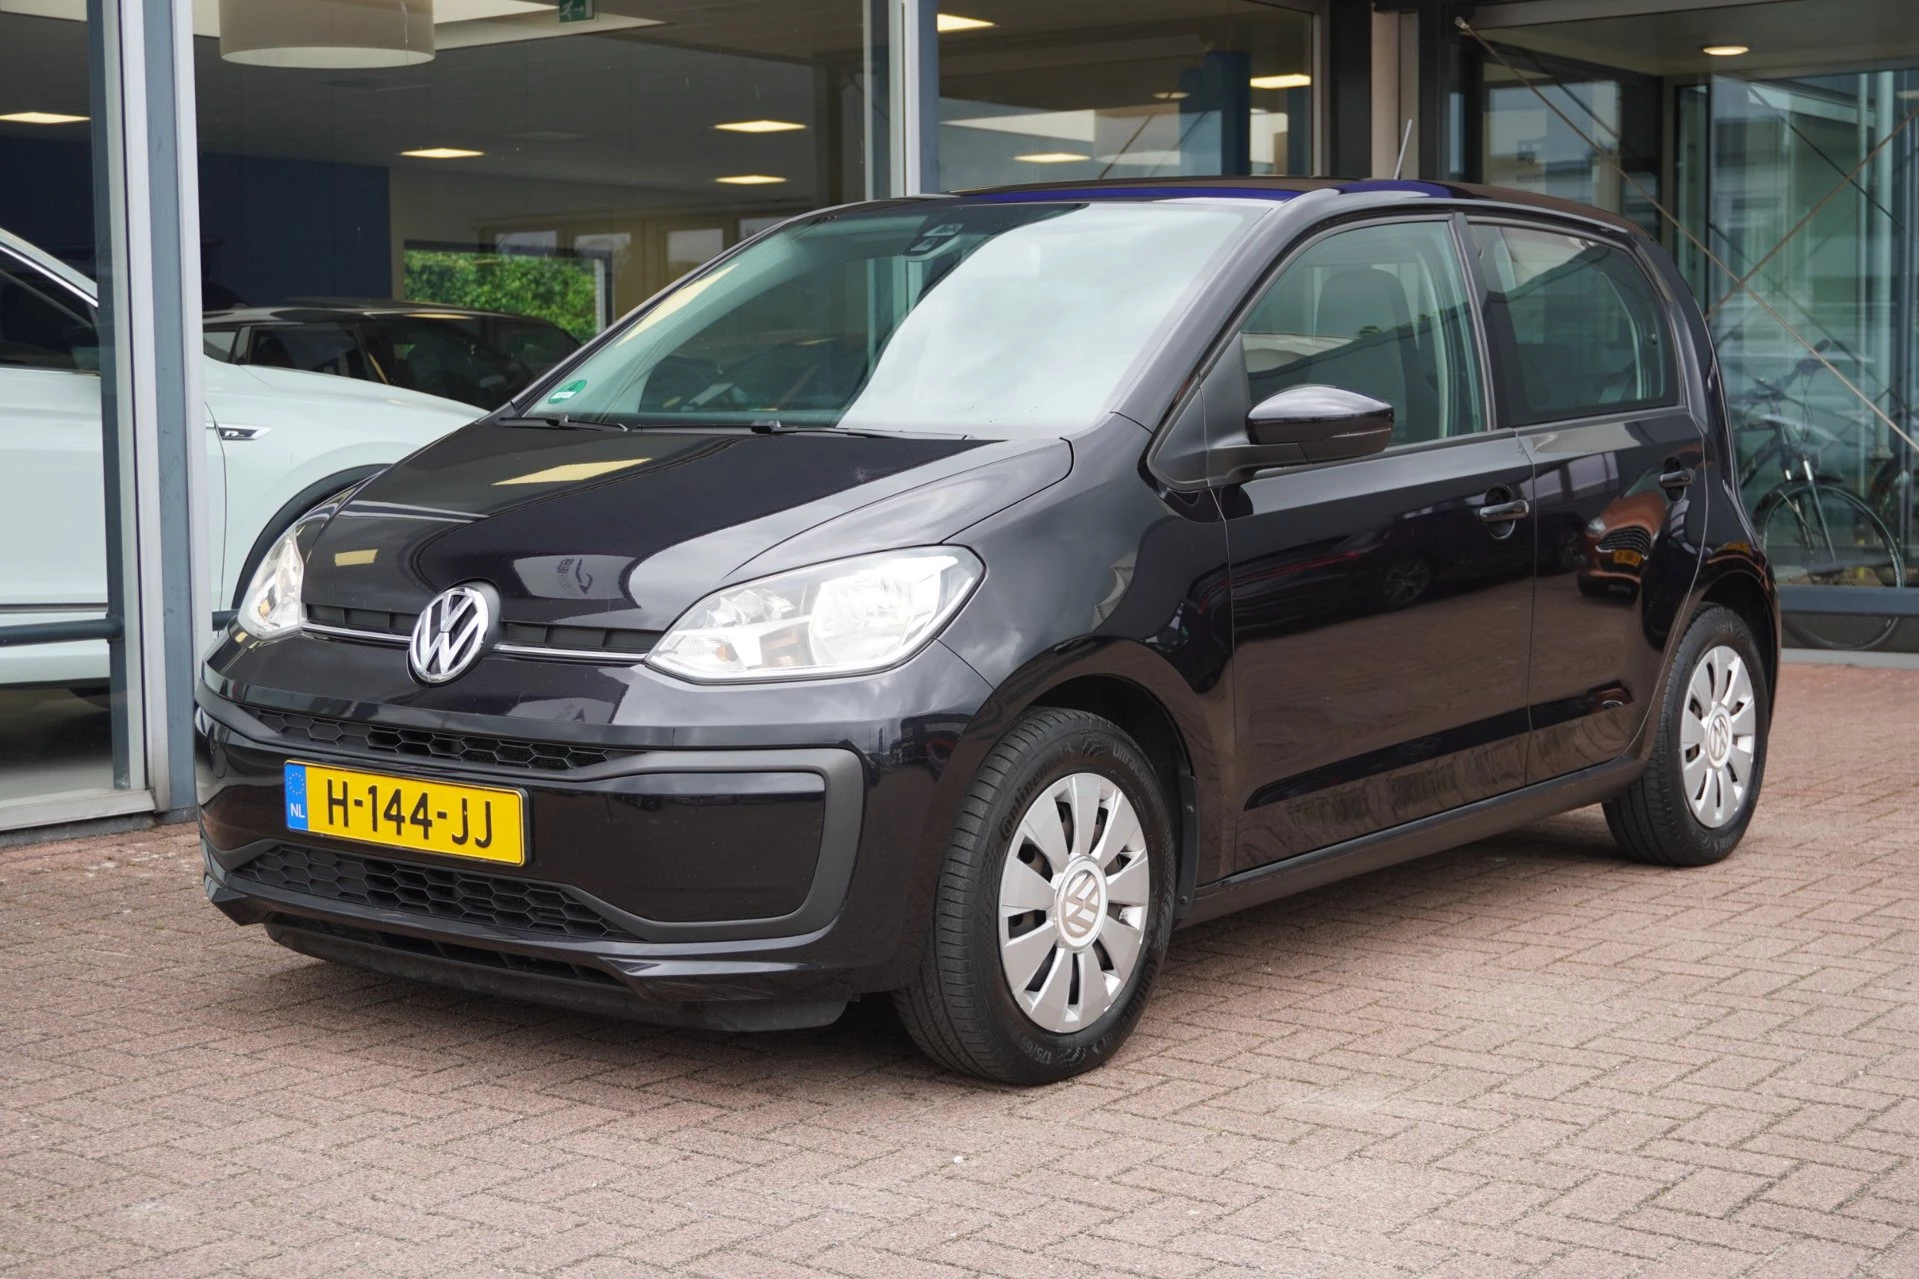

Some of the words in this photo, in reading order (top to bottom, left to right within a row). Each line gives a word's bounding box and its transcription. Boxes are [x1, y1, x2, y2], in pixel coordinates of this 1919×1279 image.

[410, 587, 488, 683] VW
[290, 802, 306, 819] NL
[327, 778, 493, 849] H-144-JJ
